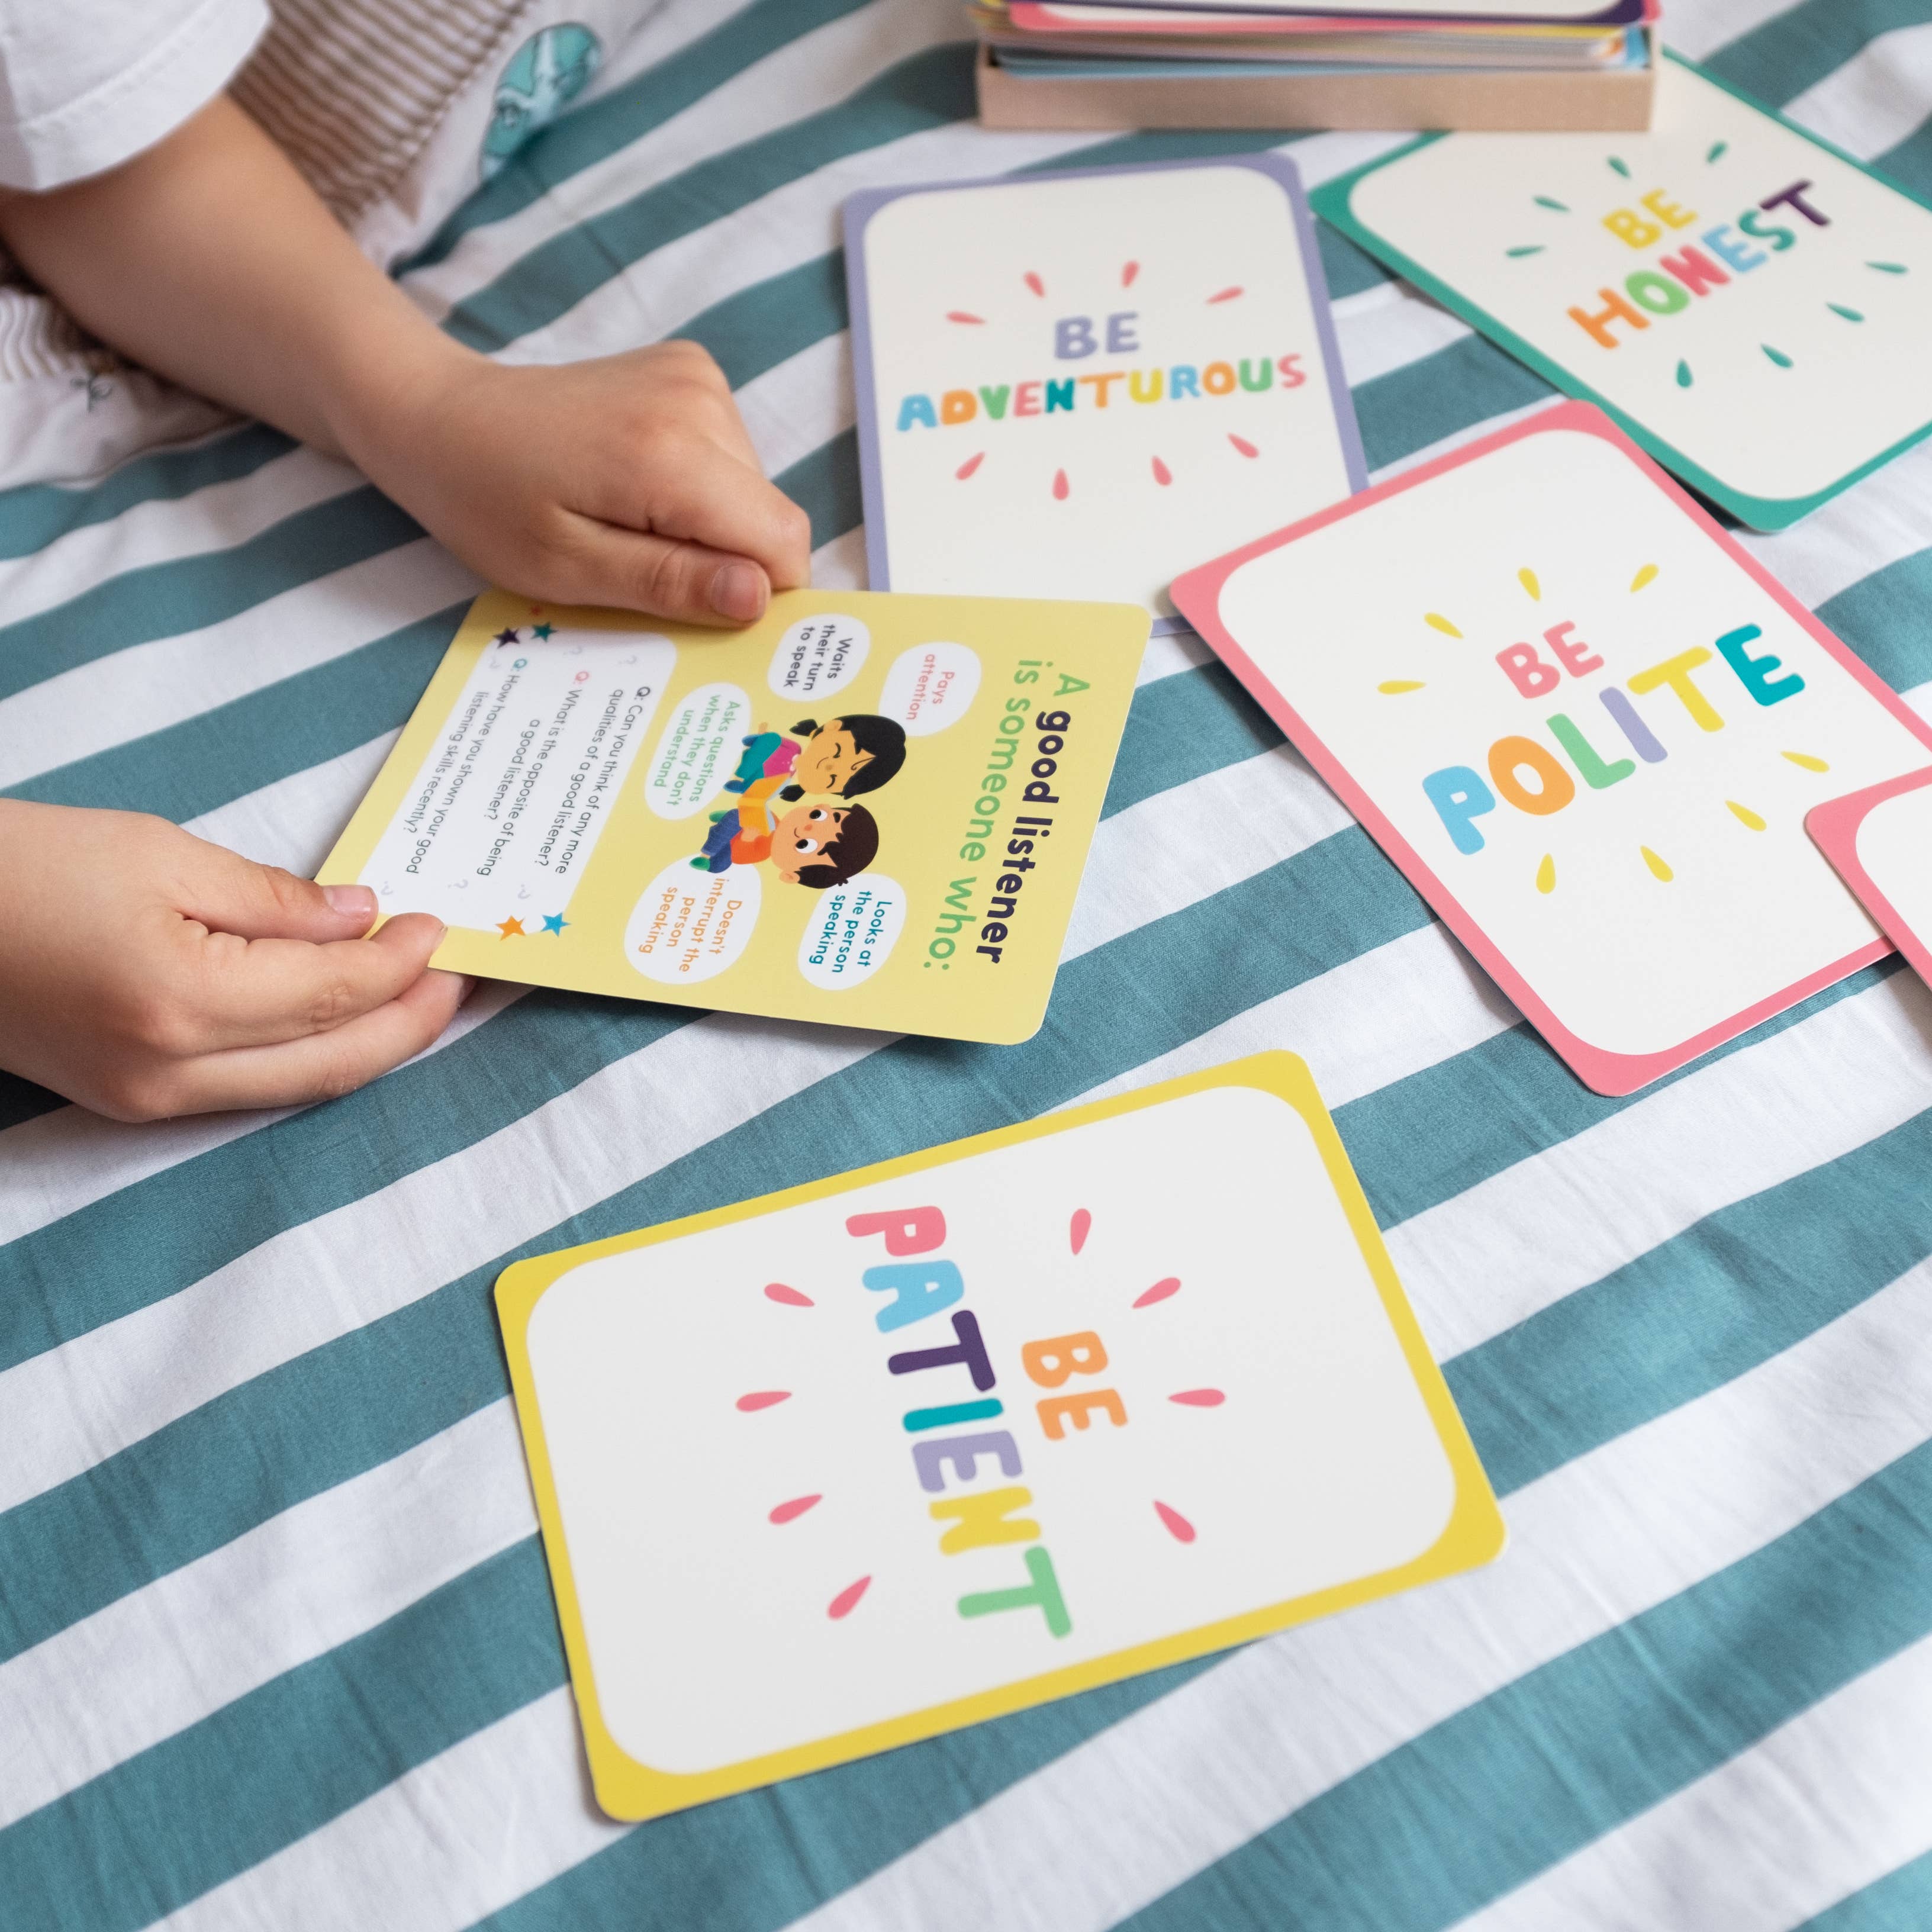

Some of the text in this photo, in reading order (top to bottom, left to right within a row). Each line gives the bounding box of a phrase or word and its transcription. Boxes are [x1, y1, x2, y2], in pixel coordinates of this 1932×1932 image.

[1602, 188, 1698, 249] BE
[1567, 179, 1831, 349] HONEST
[1054, 311, 1140, 360] BE
[896, 354, 1306, 432] ADVENTUROUS
[784, 626, 814, 687] to speak
[803, 624, 836, 690] their turn
[827, 638, 852, 679] Waits
[906, 654, 935, 720] attention
[933, 671, 955, 704] Pays
[1495, 620, 1605, 698] BE
[585, 746, 598, 759] of
[592, 690, 623, 742] qualities
[653, 710, 694, 787] understand
[666, 694, 721, 805] when they don't
[690, 701, 740, 802] Asks questions
[1422, 623, 1805, 855] POLITE
[403, 691, 488, 833] listening skills recently?
[406, 658, 528, 874] Q: How have you shown your good
[476, 671, 590, 876] Q: What is the opposite of being
[484, 719, 540, 820] a good listener?
[555, 687, 651, 874] Q: Can you think of any more
[562, 774, 585, 808] good
[534, 811, 572, 866] listener?
[923, 659, 1053, 971] is someone who:
[977, 672, 1090, 963] A good listener
[638, 887, 677, 953] speaking
[666, 897, 695, 947] person
[679, 878, 729, 972] interrupt the
[709, 900, 742, 954] Doesn't
[809, 895, 845, 964] speaking
[832, 891, 872, 973] the person
[857, 901, 892, 966] Looks at
[845, 1206, 1072, 1639] PATIENT
[1022, 1331, 1128, 1441] BE
